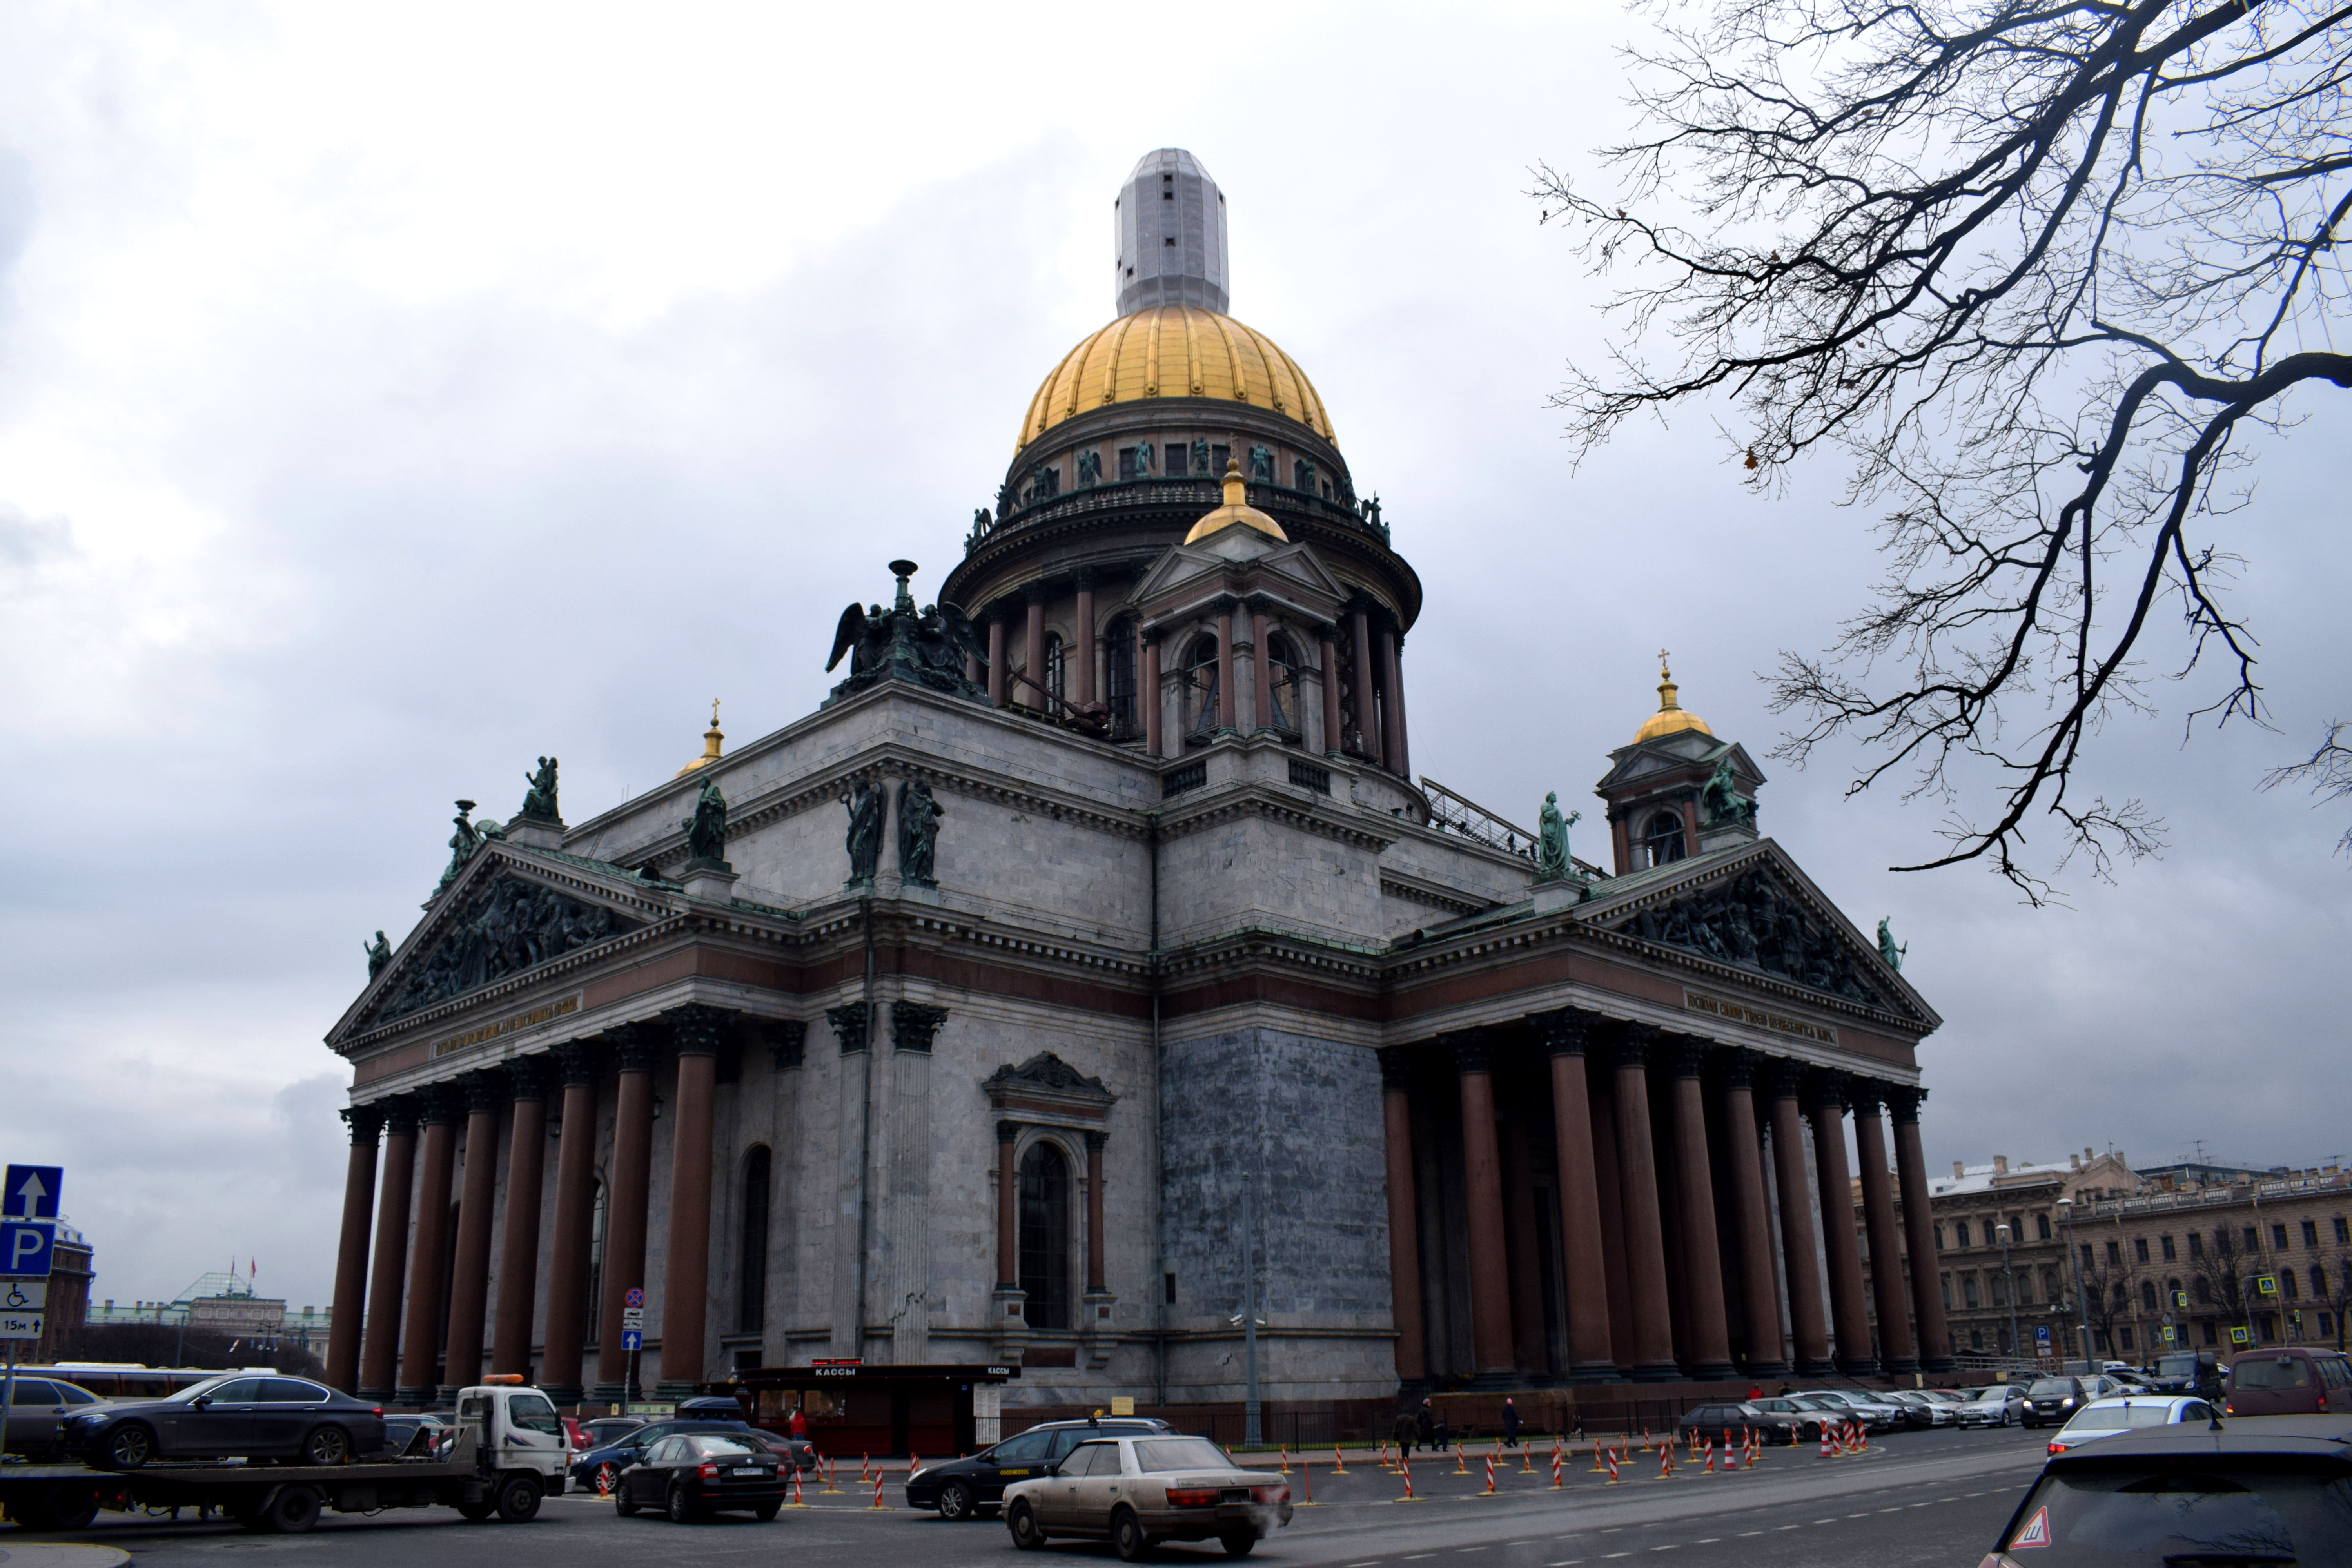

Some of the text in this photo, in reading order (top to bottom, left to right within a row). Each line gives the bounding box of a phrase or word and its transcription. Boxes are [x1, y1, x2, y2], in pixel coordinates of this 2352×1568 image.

[11, 1229, 44, 1269] P
[2038, 1328, 2045, 1338] P
[2024, 1526, 2042, 1541] Ш
